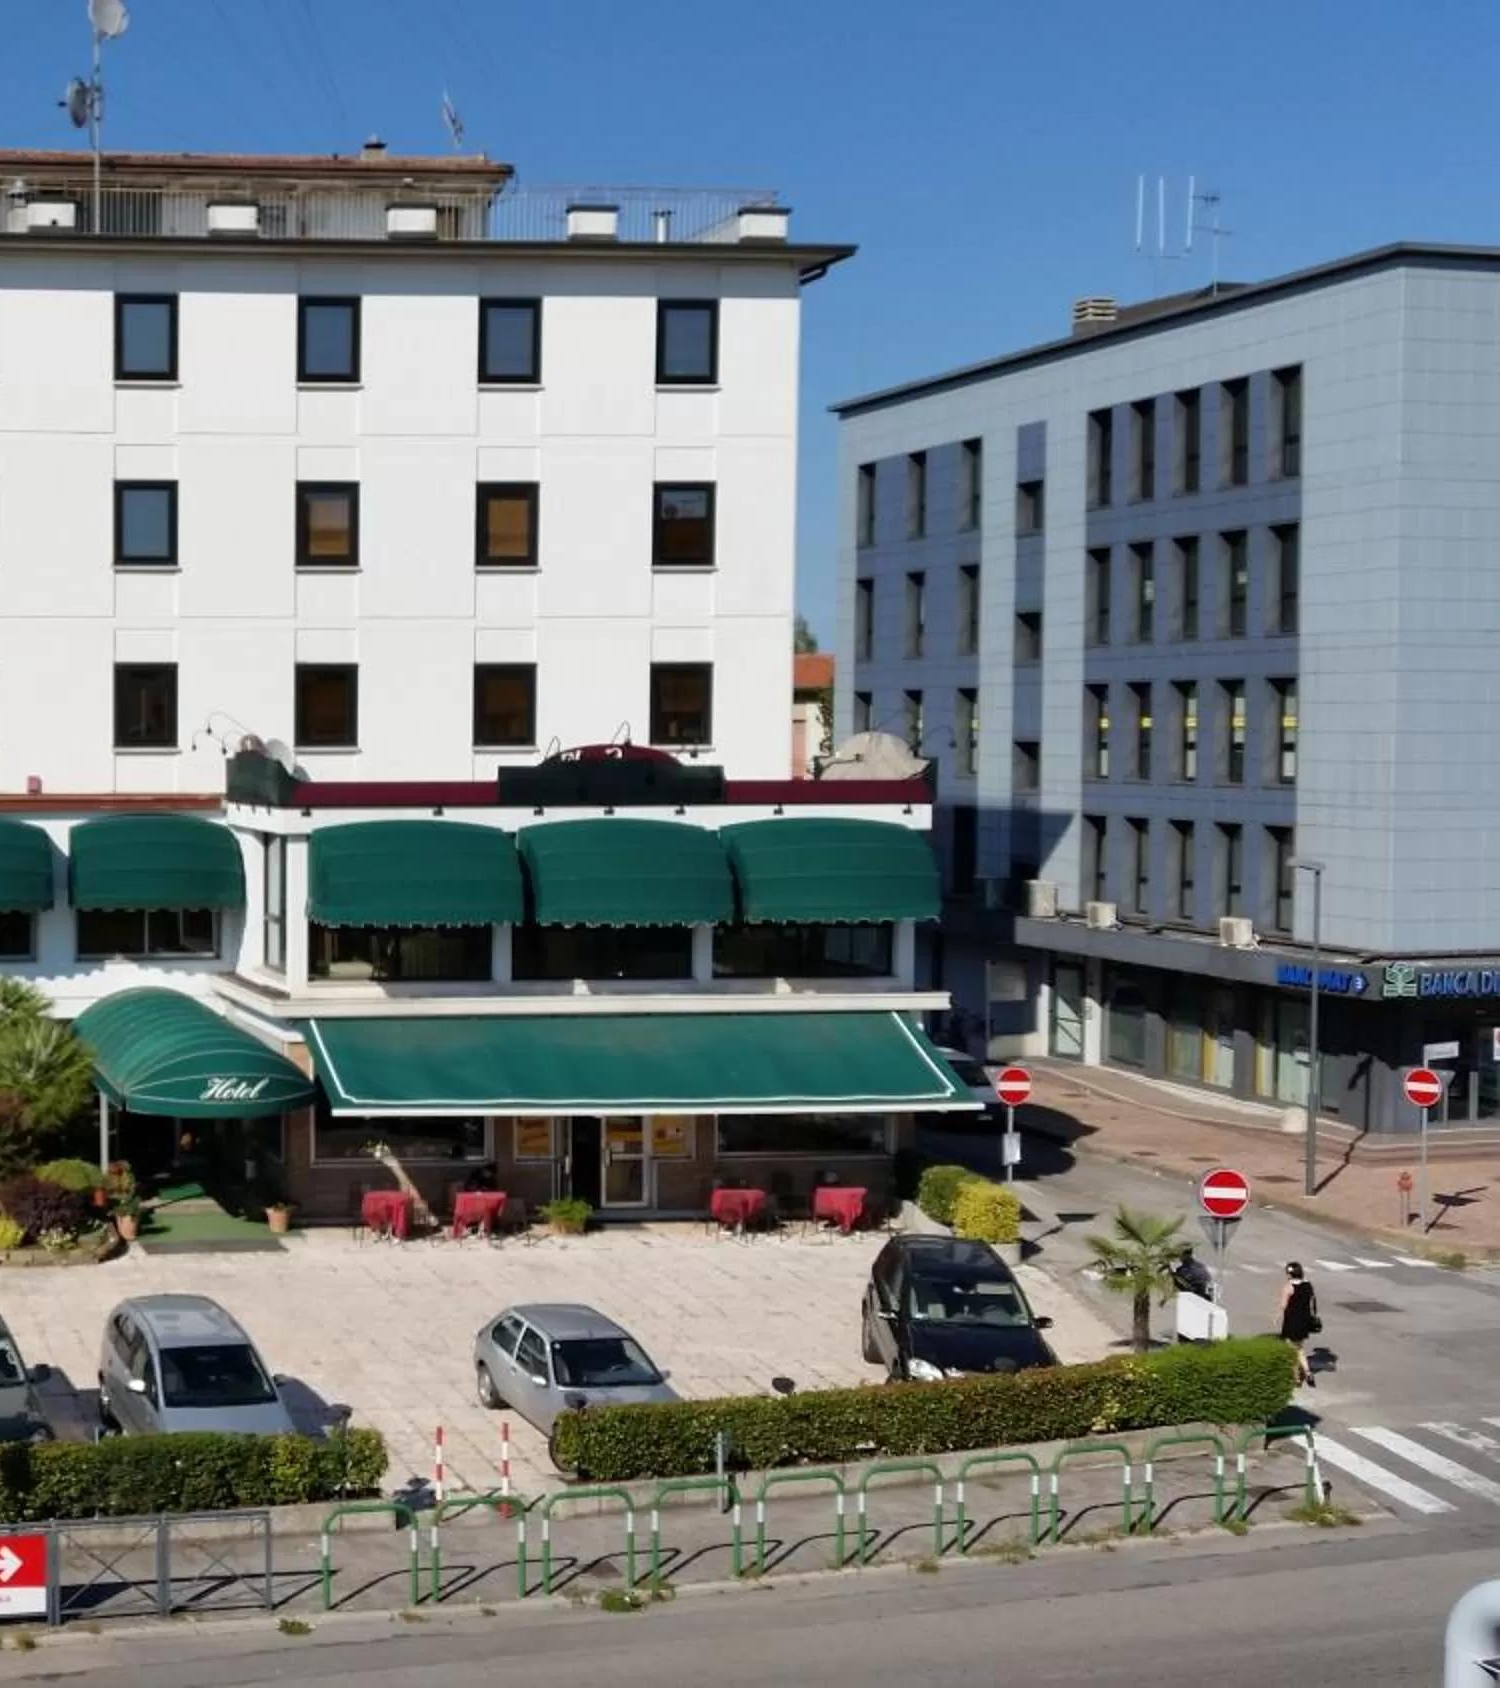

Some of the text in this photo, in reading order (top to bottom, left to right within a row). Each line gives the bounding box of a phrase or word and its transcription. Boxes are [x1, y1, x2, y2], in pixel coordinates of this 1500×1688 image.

[1277, 964, 1350, 992] BANCMAT
[1420, 971, 1477, 995] BANCA
[199, 1076, 269, 1099] Hotel
